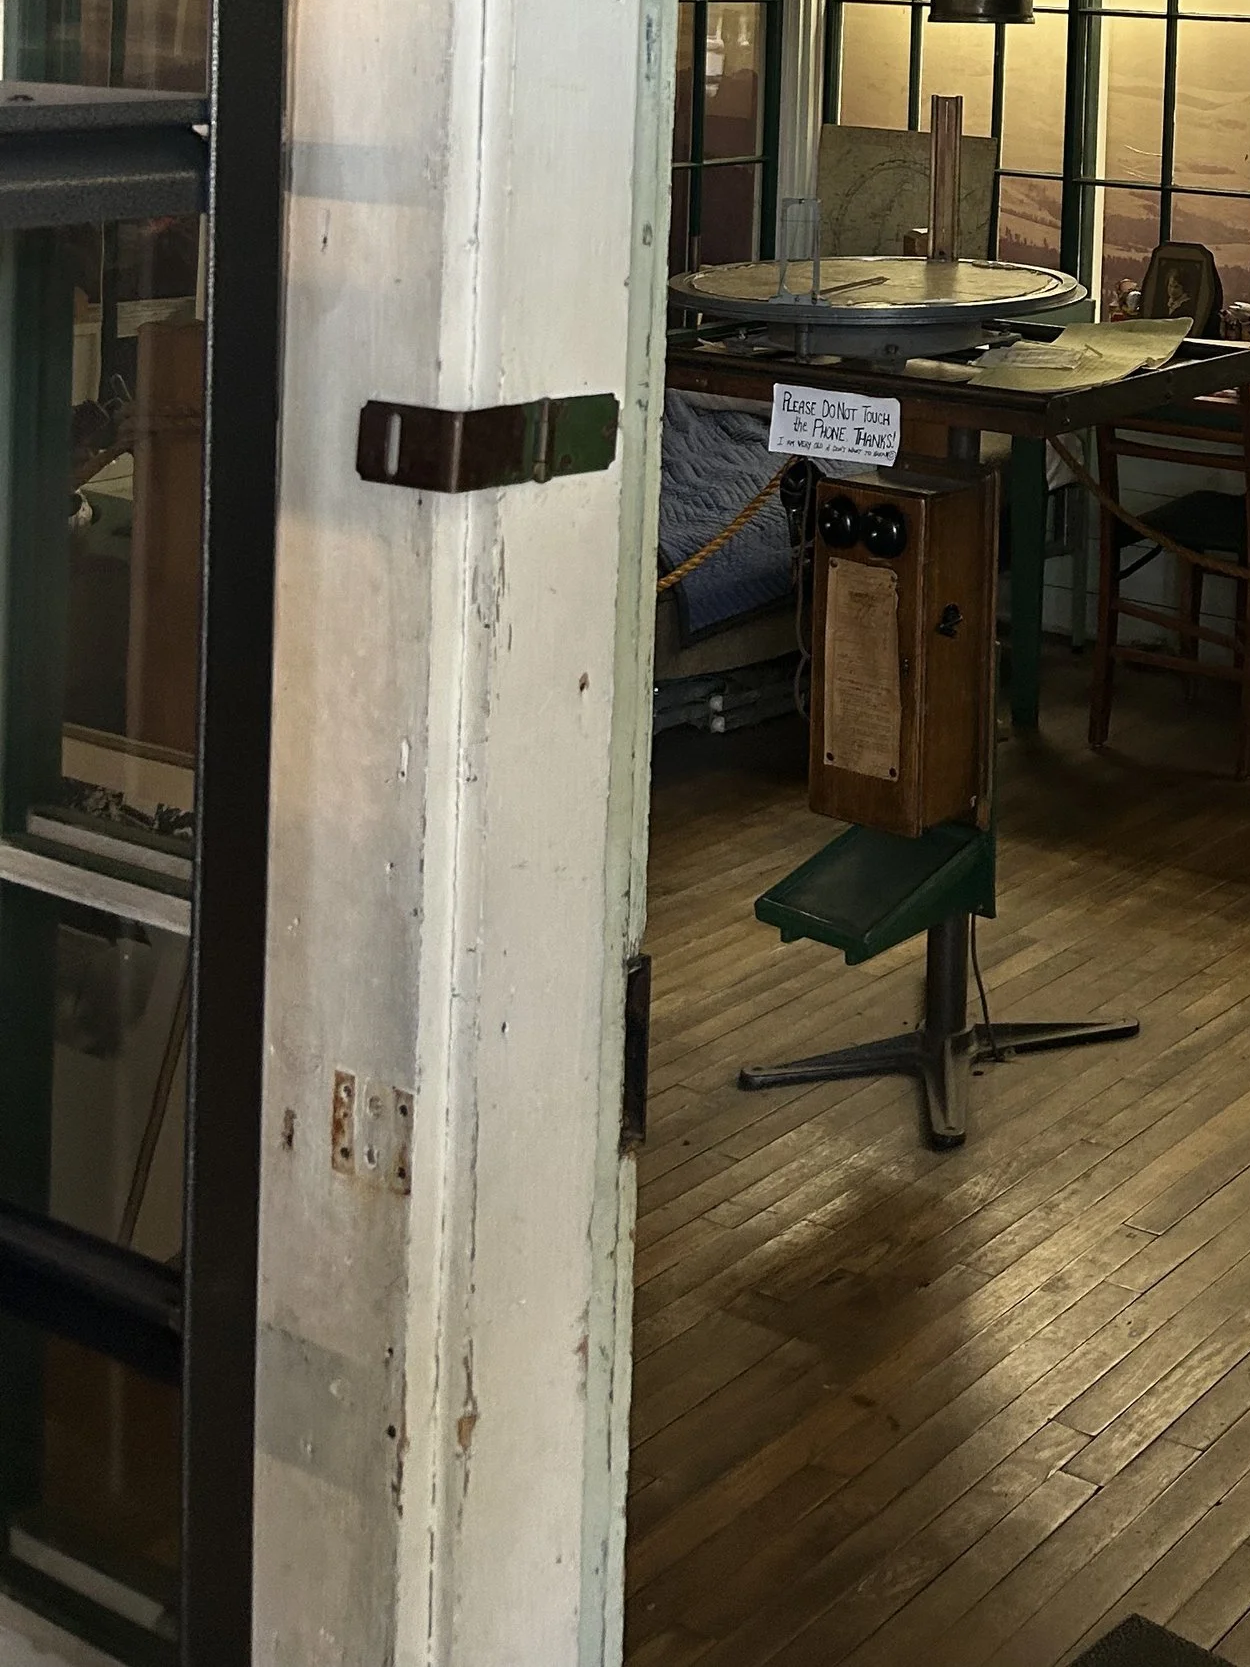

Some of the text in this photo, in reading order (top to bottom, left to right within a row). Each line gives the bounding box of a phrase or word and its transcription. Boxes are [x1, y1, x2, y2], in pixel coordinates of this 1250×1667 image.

[782, 391, 816, 416] PLEASE
[862, 405, 890, 426] TOUCH
[776, 436, 784, 445] I
[797, 439, 811, 450] VERY
[793, 416, 807, 432] the
[854, 427, 896, 449] THANKS!
